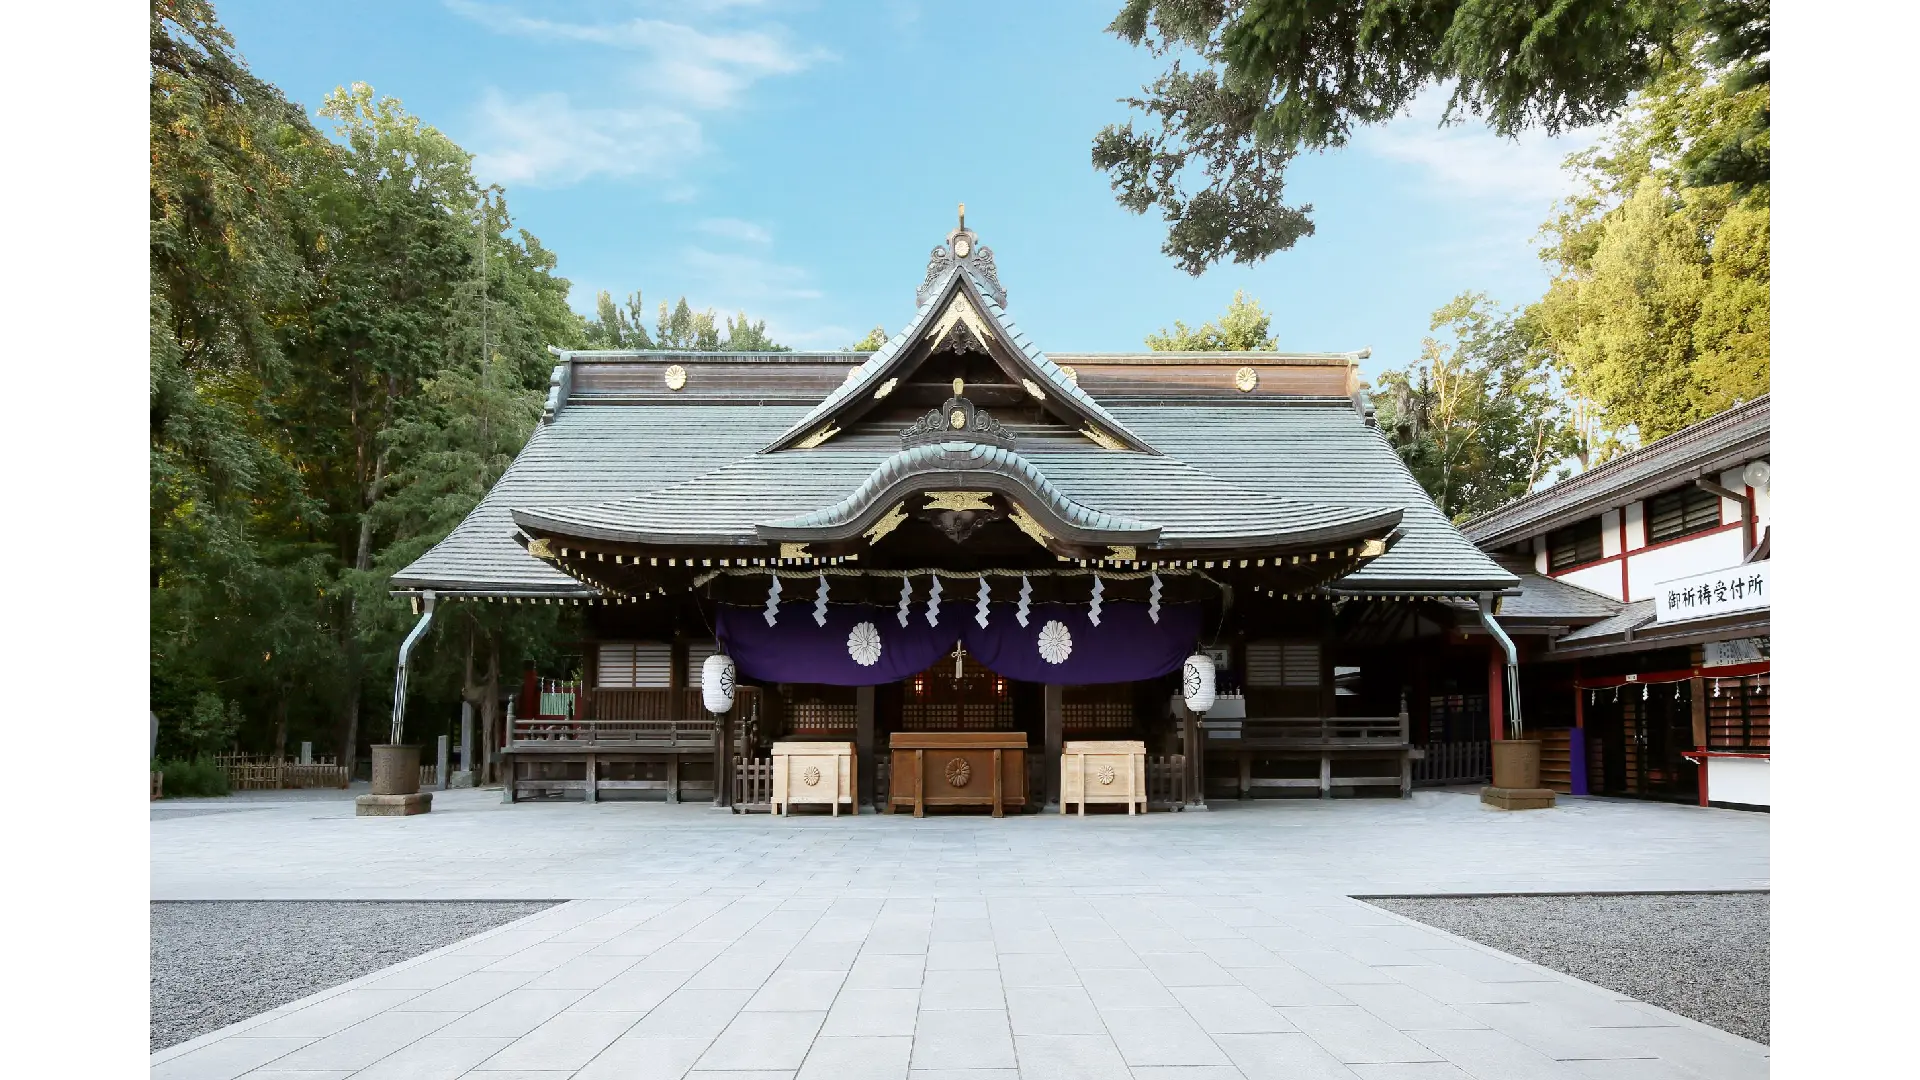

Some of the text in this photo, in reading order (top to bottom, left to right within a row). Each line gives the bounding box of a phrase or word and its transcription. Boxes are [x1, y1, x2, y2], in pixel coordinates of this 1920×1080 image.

[1668, 574, 1763, 609] 御祈祷受付所
